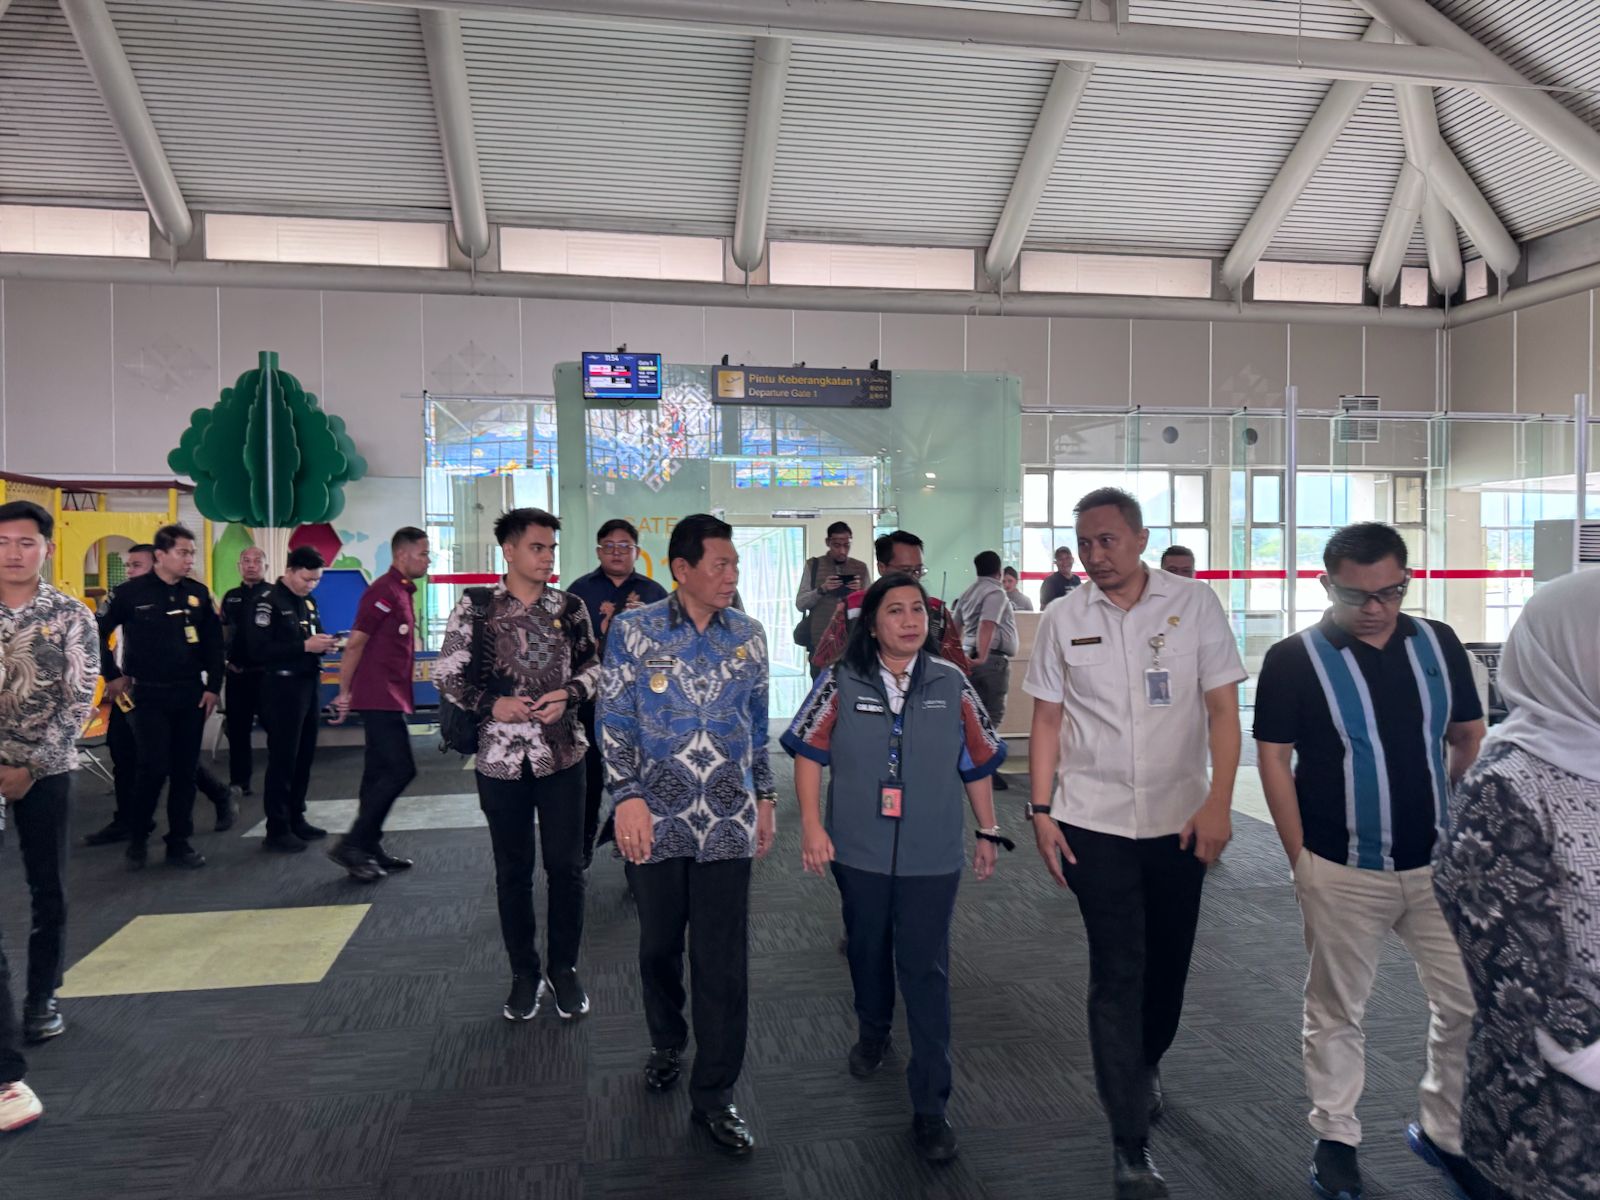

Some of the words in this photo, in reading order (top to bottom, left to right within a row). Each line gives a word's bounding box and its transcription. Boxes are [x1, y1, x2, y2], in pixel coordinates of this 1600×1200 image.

[749, 374, 776, 384] Pintu
[778, 374, 853, 388] Keberangkatan
[748, 388, 789, 398] Departure
[791, 389, 811, 398] Gate
